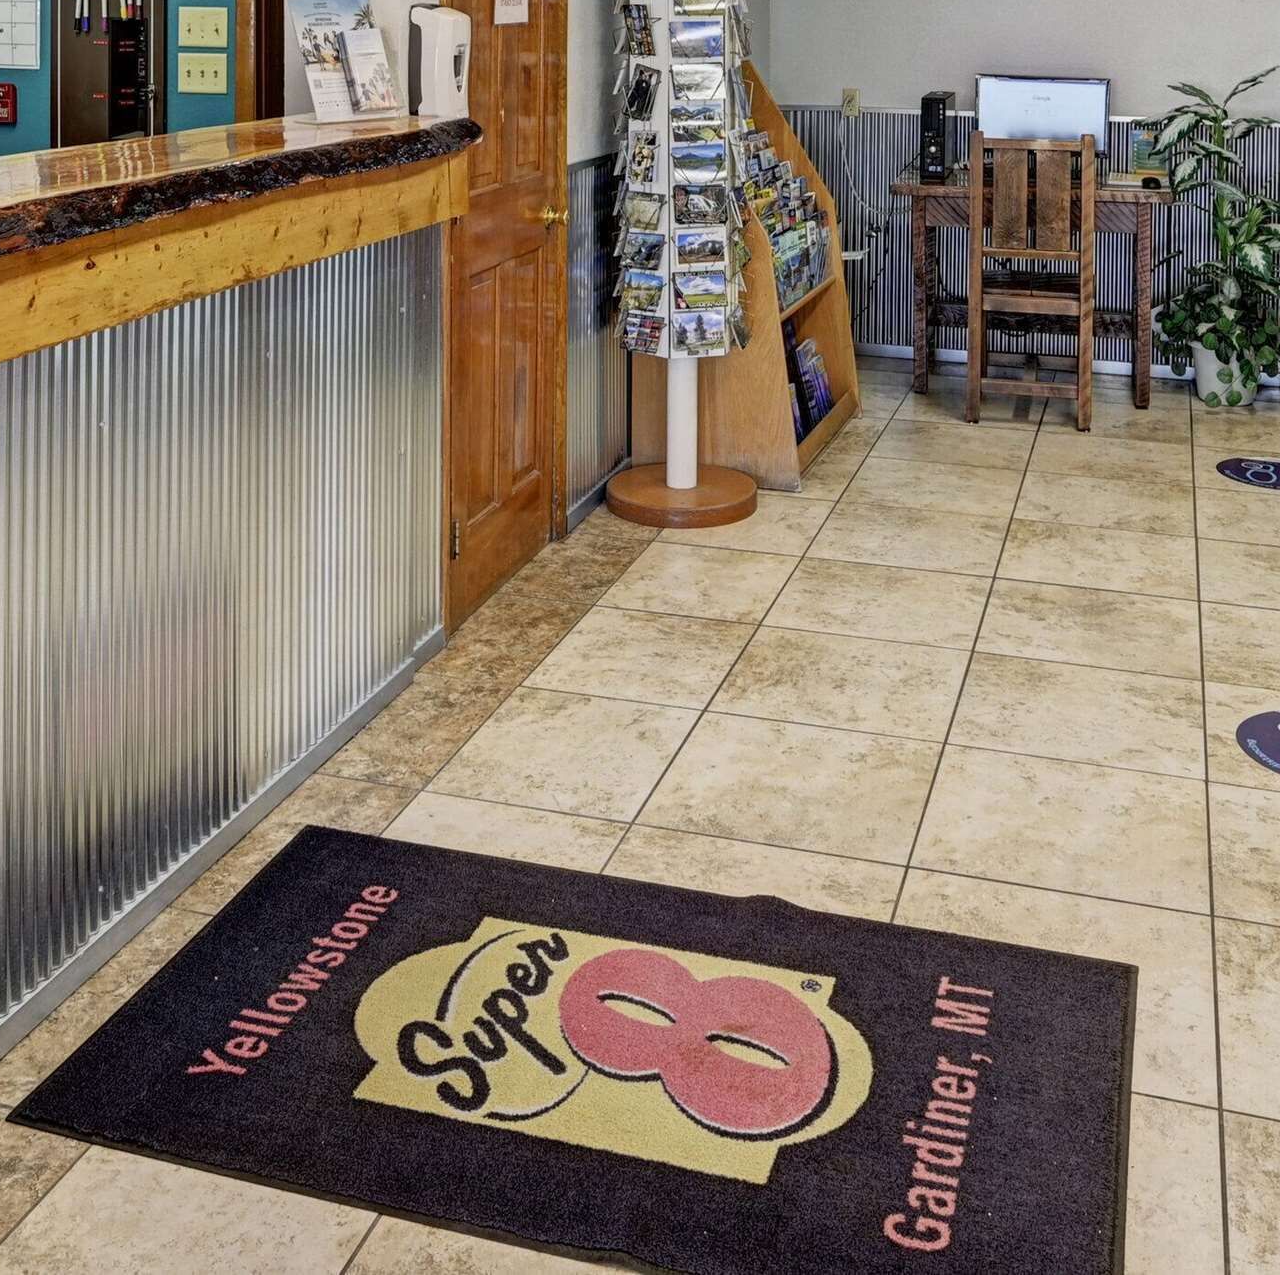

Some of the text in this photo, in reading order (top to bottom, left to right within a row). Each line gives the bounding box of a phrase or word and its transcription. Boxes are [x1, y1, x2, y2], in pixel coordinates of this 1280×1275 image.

[188, 885, 400, 1075] Yellowstone
[397, 932, 570, 1113] Super
[559, 948, 840, 1143] 8
[883, 976, 996, 1253] Gardiner, MT
